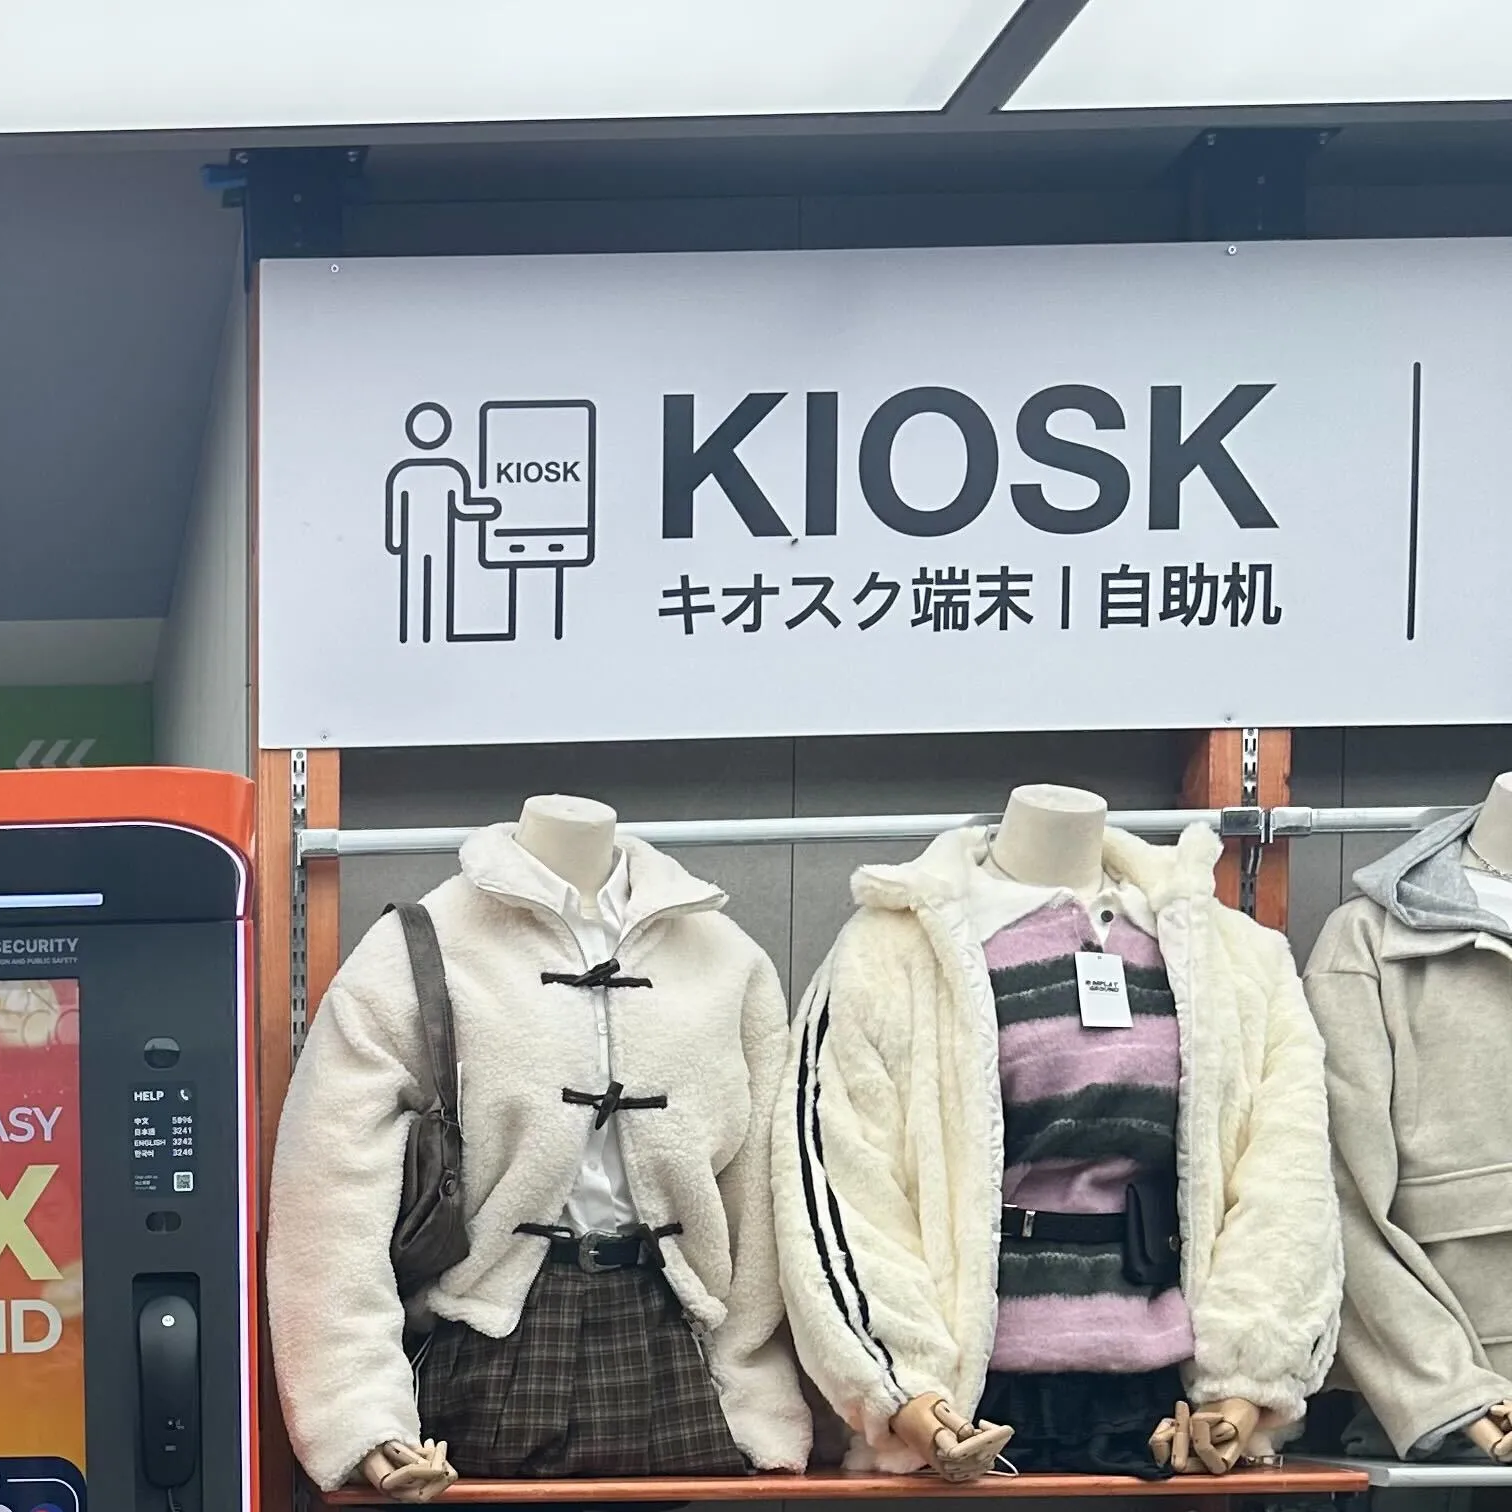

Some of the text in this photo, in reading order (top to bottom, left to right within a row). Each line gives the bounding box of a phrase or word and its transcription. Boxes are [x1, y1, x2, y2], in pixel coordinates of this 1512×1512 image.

[496, 461, 581, 483] KIOSK
[661, 383, 1280, 539] KIOSK
[657, 565, 1034, 636] キオスク端末
[1099, 561, 1282, 629] 自助机
[134, 1090, 165, 1102] HELP
[172, 1126, 192, 1135] 3241
